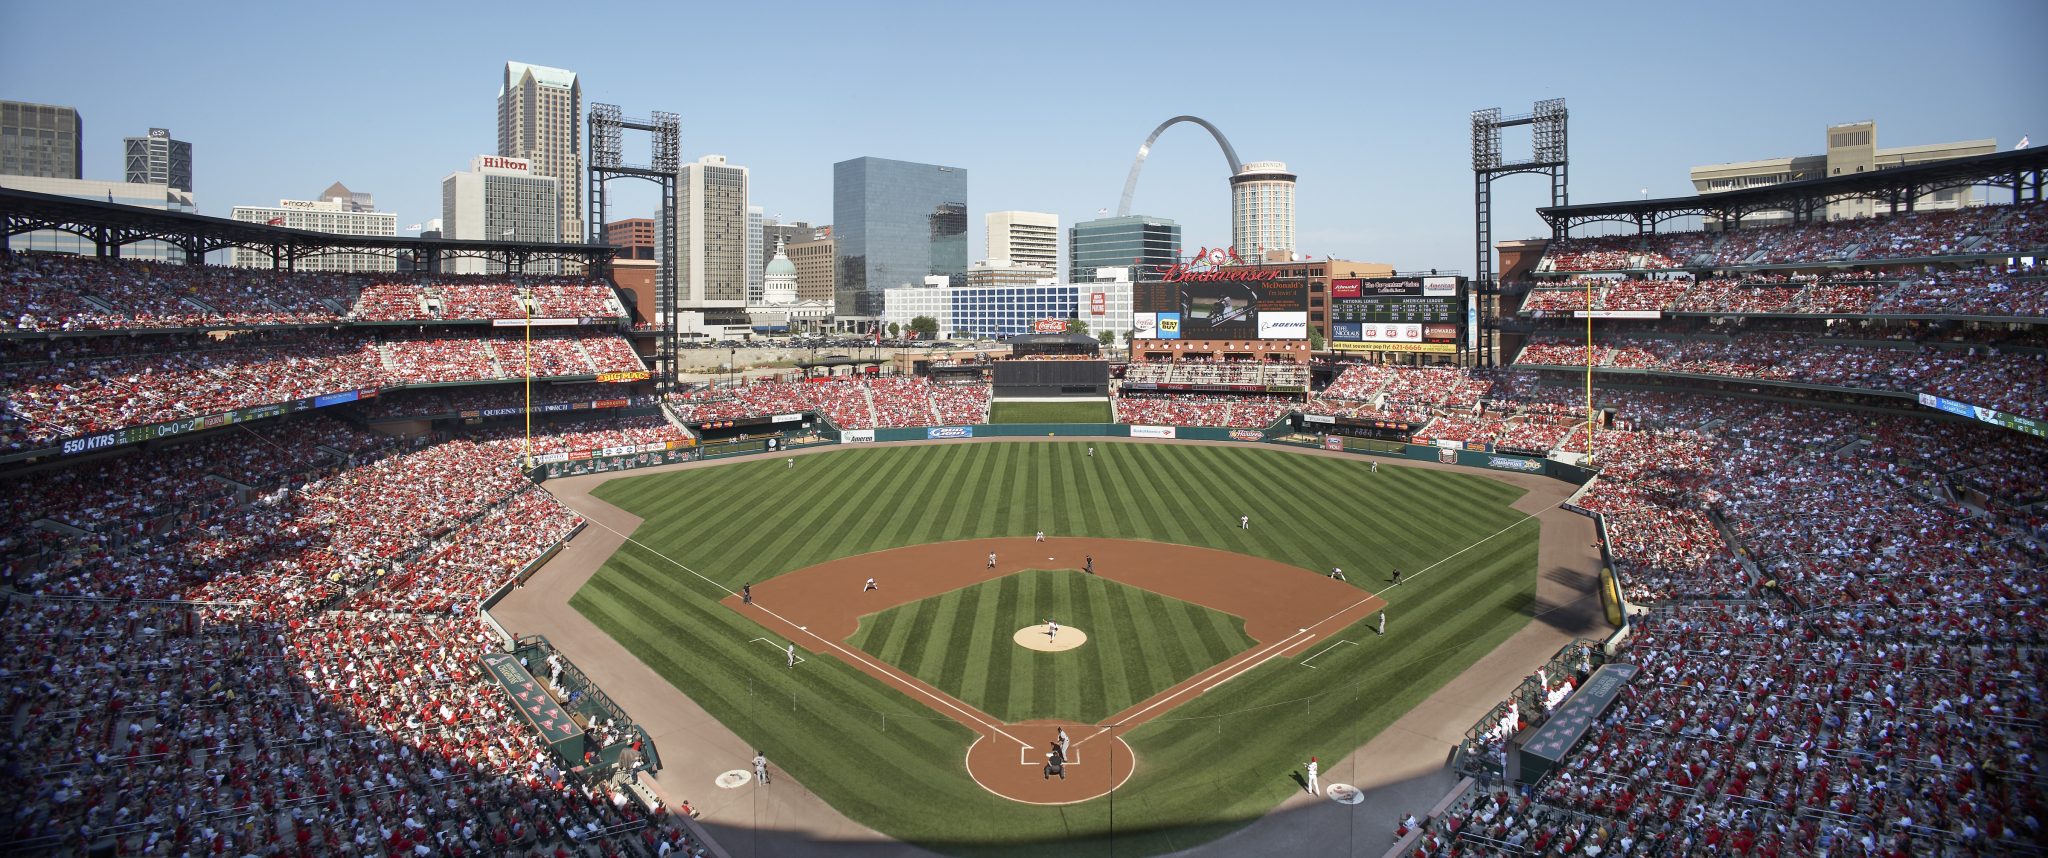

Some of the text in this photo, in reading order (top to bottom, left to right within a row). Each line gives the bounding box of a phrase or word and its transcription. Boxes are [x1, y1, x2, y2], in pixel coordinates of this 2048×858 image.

[483, 156, 528, 171] Hilton
[1156, 263, 1280, 283] Budweiser
[1262, 281, 1304, 289] McDonald's
[603, 372, 645, 382] BIG MAC
[64, 433, 116, 454] 550 KTRS
